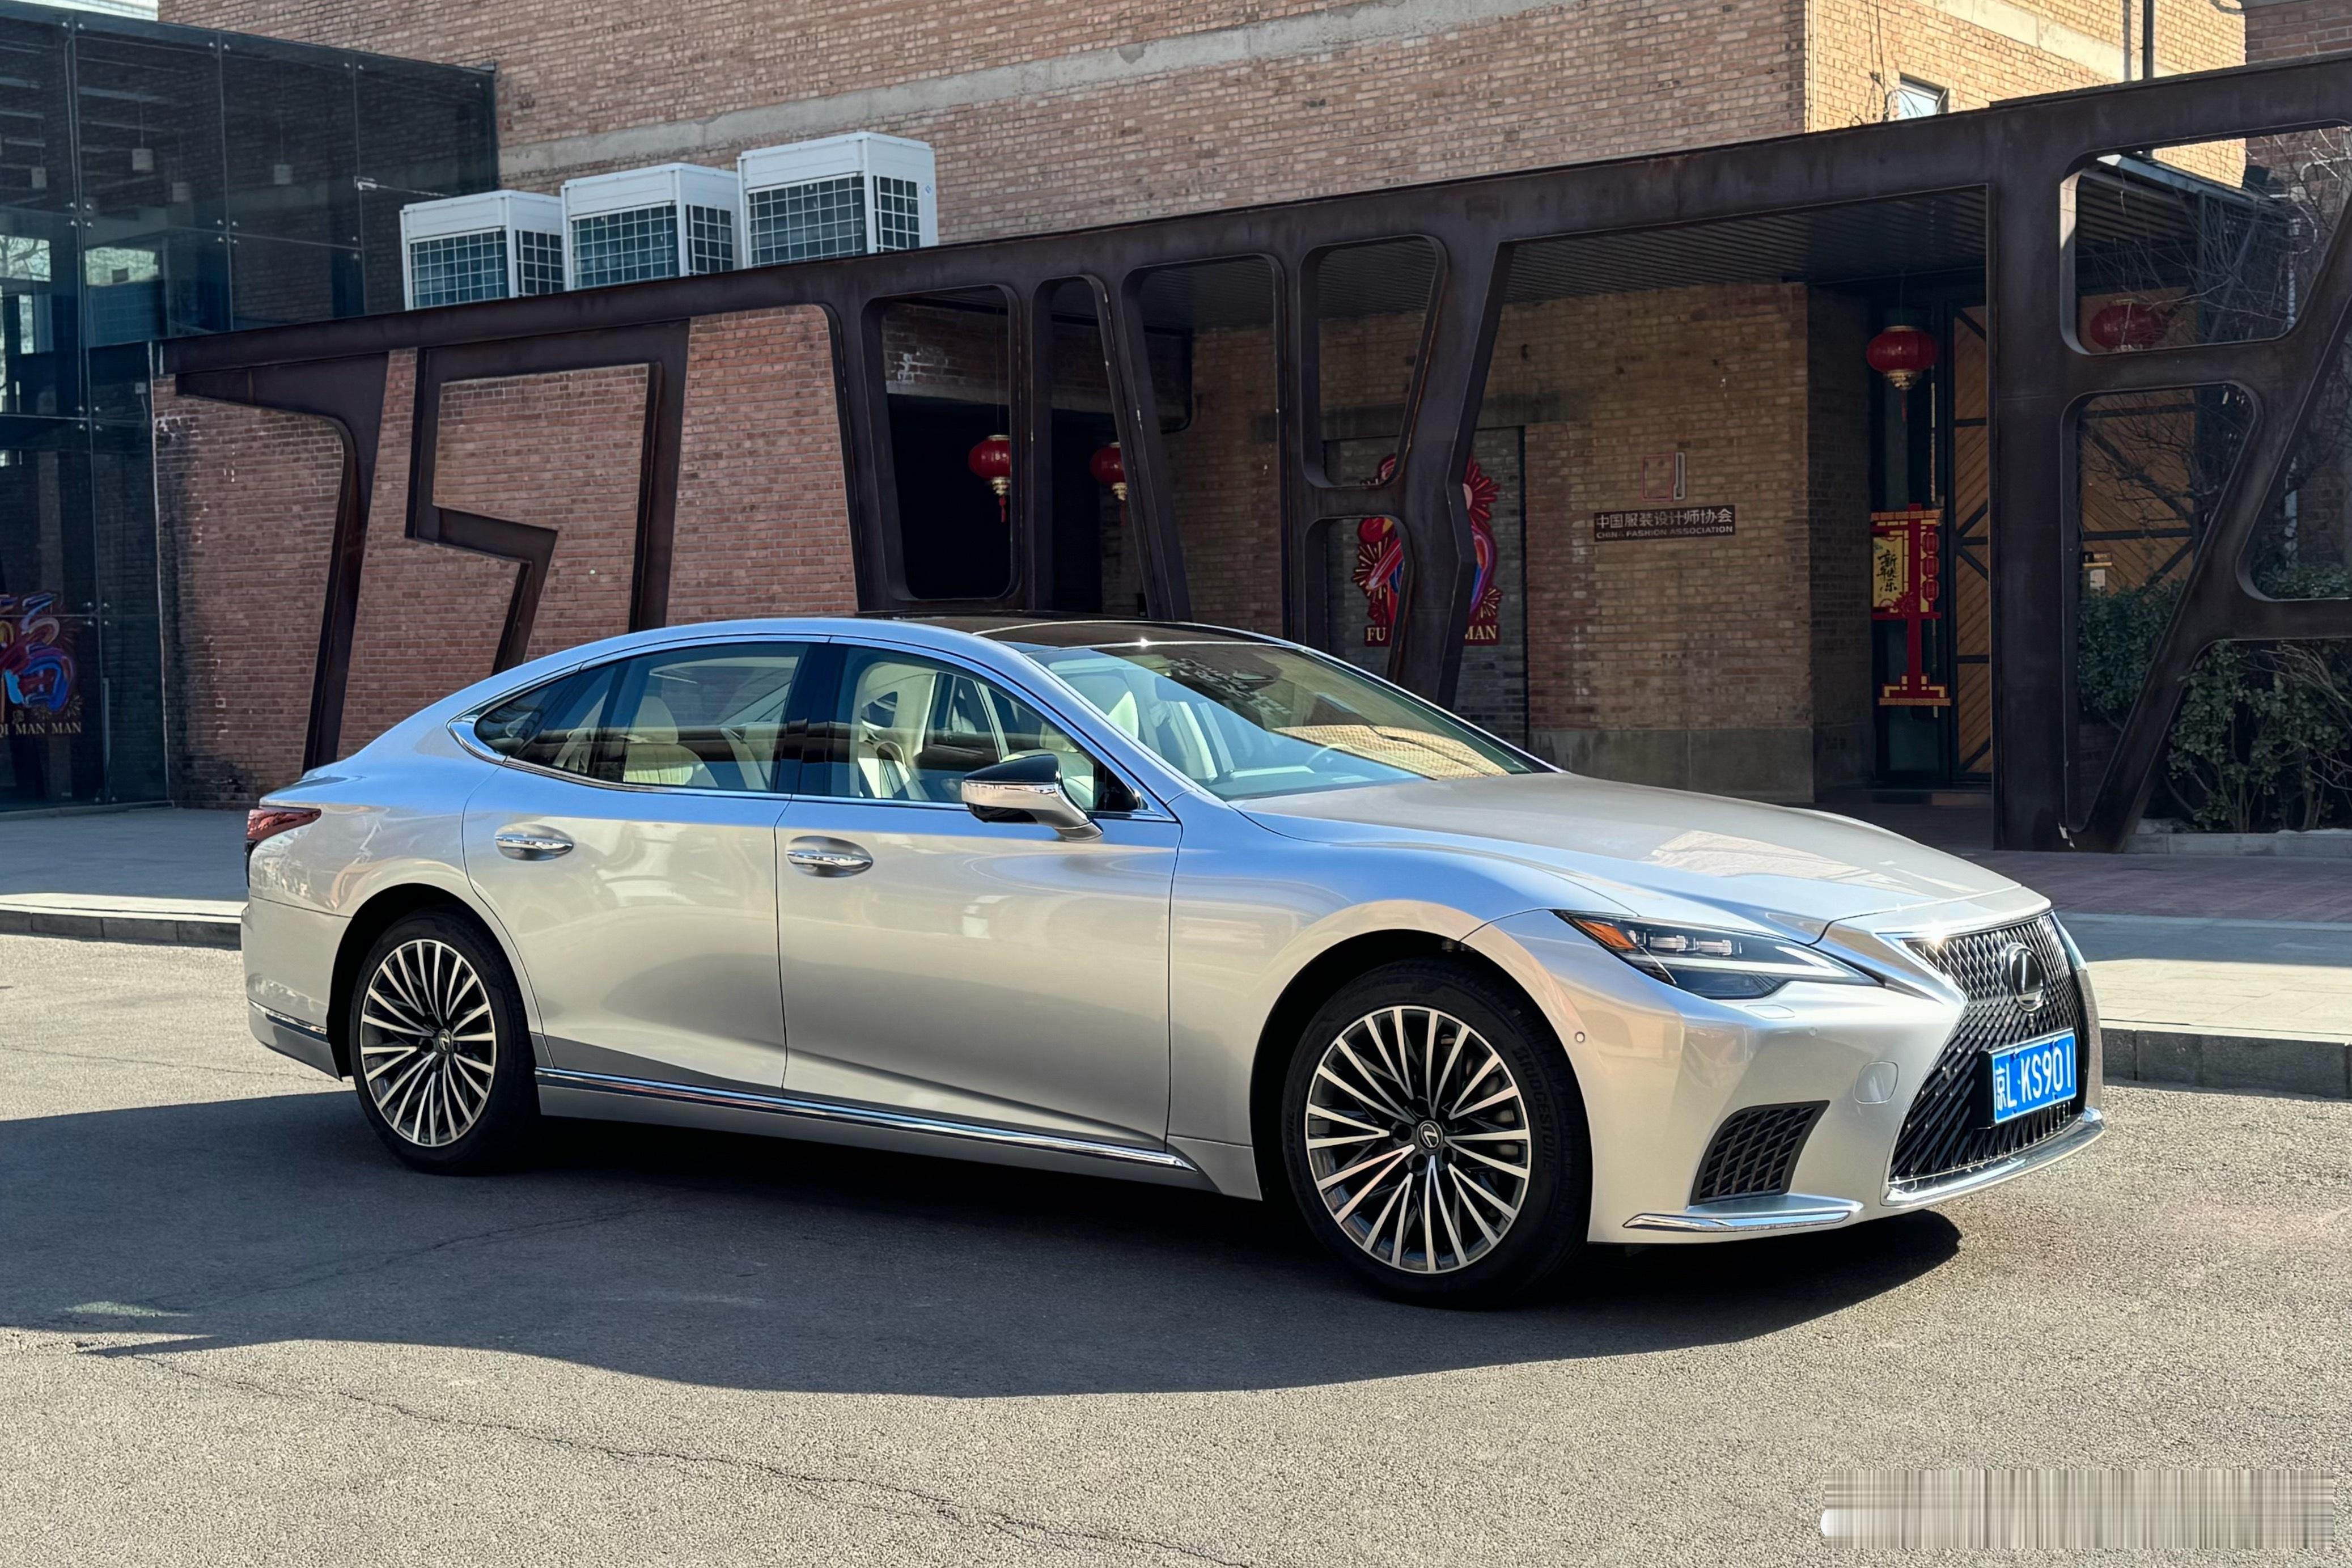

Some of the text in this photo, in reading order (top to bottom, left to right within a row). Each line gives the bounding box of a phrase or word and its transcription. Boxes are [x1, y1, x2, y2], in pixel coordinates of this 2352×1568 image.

[1596, 508, 1733, 528] 中国服装设计师协会
[1669, 526, 1733, 535] ASSOCIATION
[1367, 627, 1386, 641] FU
[16, 723, 45, 735] MAN
[52, 722, 81, 734] MAN
